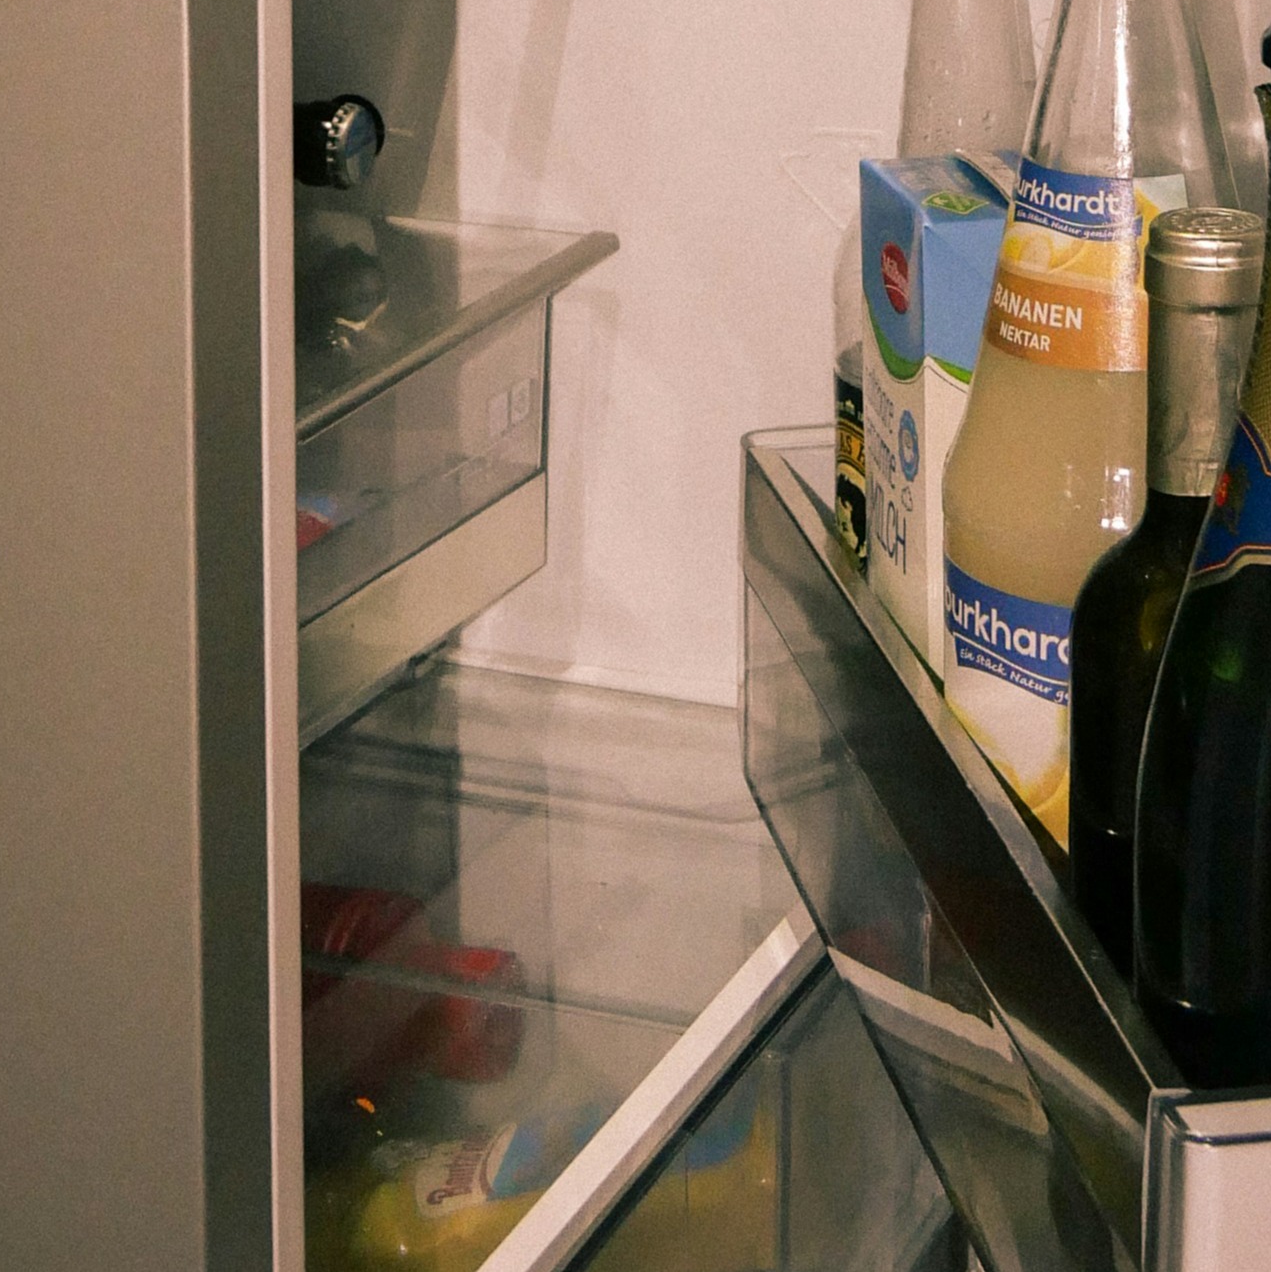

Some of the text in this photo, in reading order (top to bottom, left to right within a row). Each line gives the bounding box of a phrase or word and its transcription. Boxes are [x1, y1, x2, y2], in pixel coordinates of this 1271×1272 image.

[1051, 221, 1082, 235] Natur
[993, 282, 1083, 330] BANANEN
[999, 320, 1051, 352] NEKTAR
[1010, 670, 1053, 694] Natur
